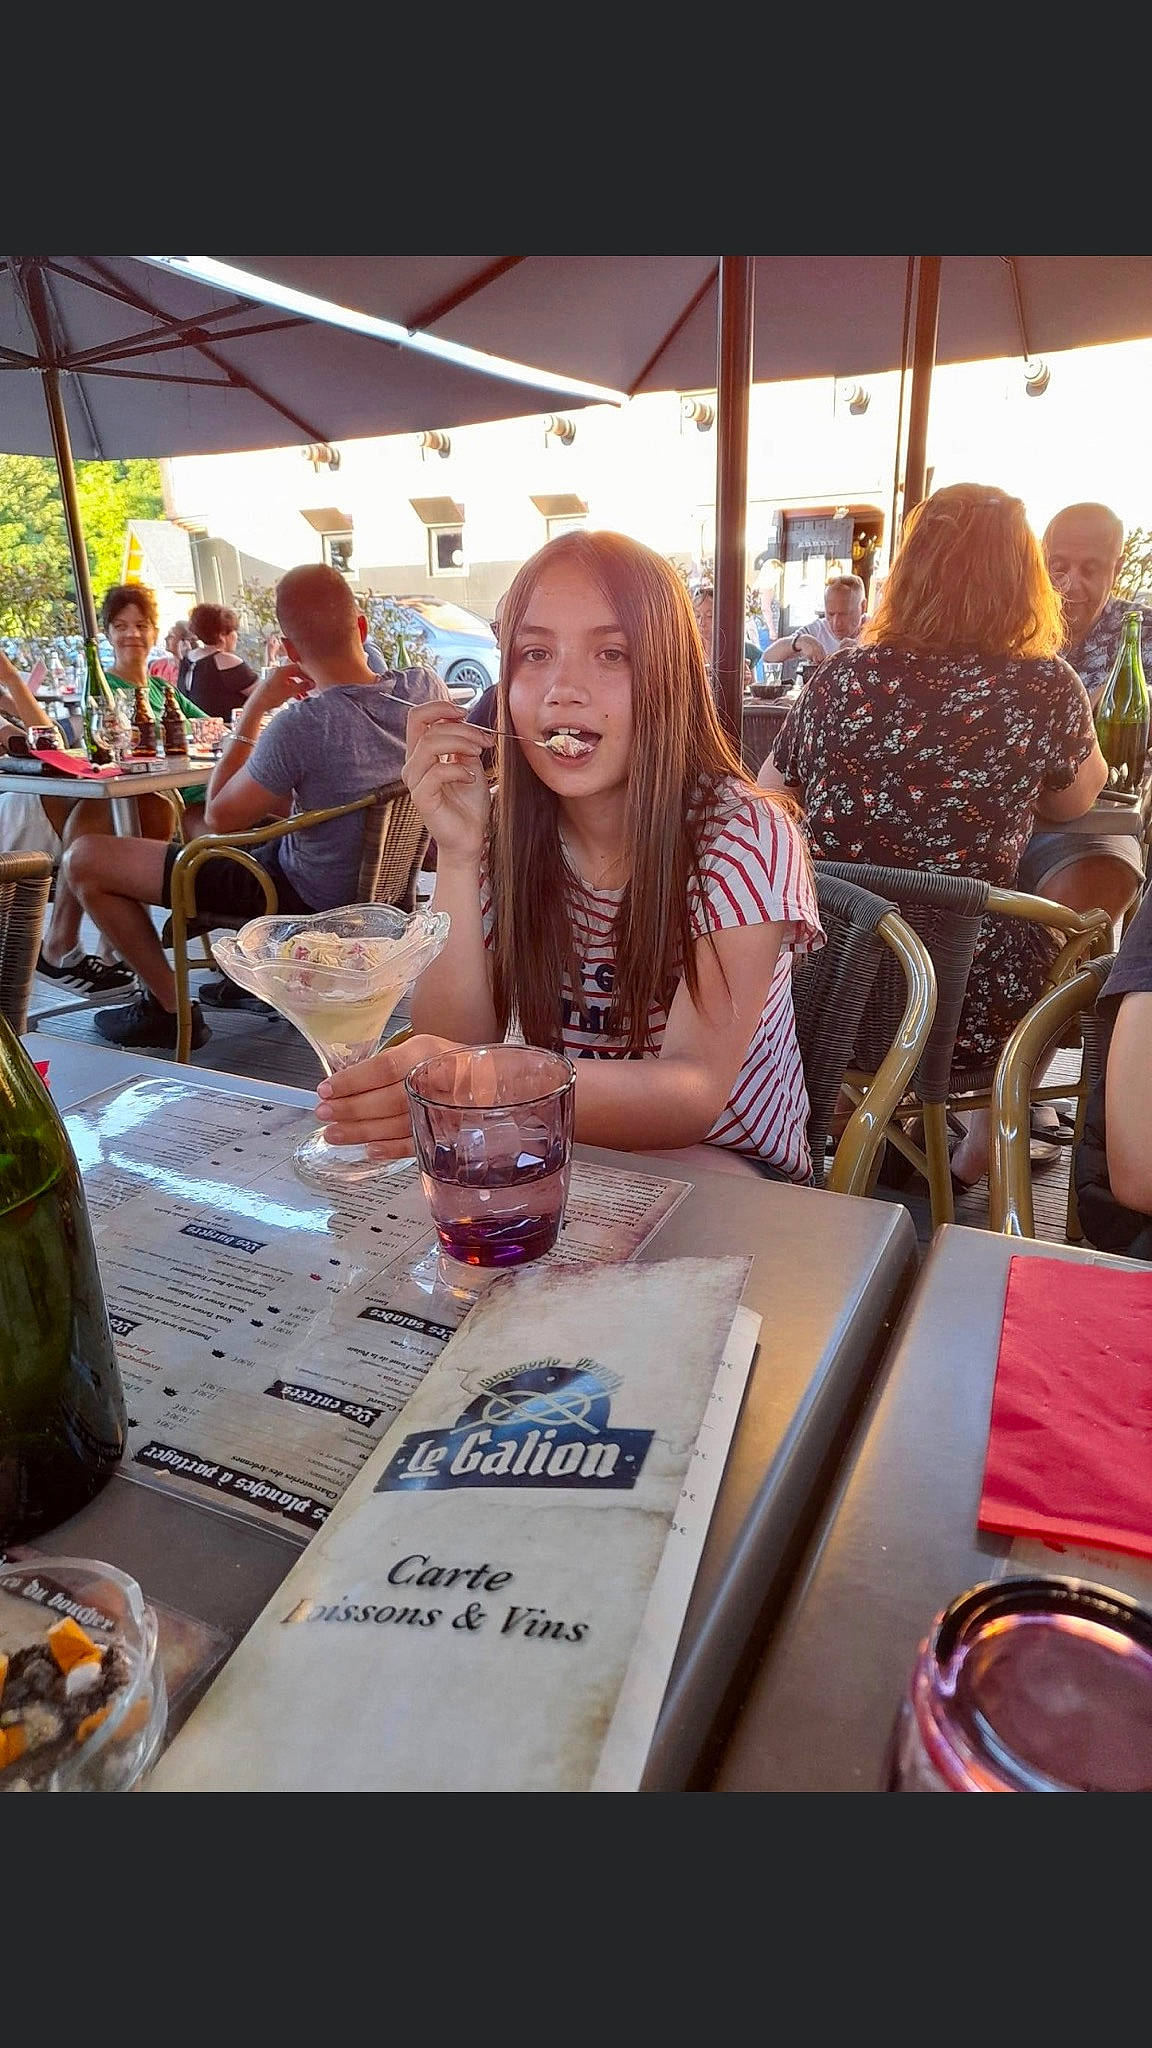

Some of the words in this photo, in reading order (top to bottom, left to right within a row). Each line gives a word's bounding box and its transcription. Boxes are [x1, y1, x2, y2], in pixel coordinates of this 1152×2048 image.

[184, 1223, 233, 1245] burgers
[232, 1236, 258, 1252] Les
[367, 1306, 425, 1332] salades
[280, 1383, 341, 1411] entrées
[342, 1403, 374, 1424] Les
[140, 1443, 220, 1480] partager
[229, 1454, 268, 1472] Ardennes
[451, 1429, 621, 1478] Galion
[215, 1470, 233, 1487] à
[267, 1466, 284, 1477] des
[231, 1475, 312, 1517] planches
[283, 1472, 339, 1499] Charcuteries
[387, 1554, 514, 1592] Carte
[452, 1602, 489, 1632] &
[500, 1604, 590, 1643] Vins
